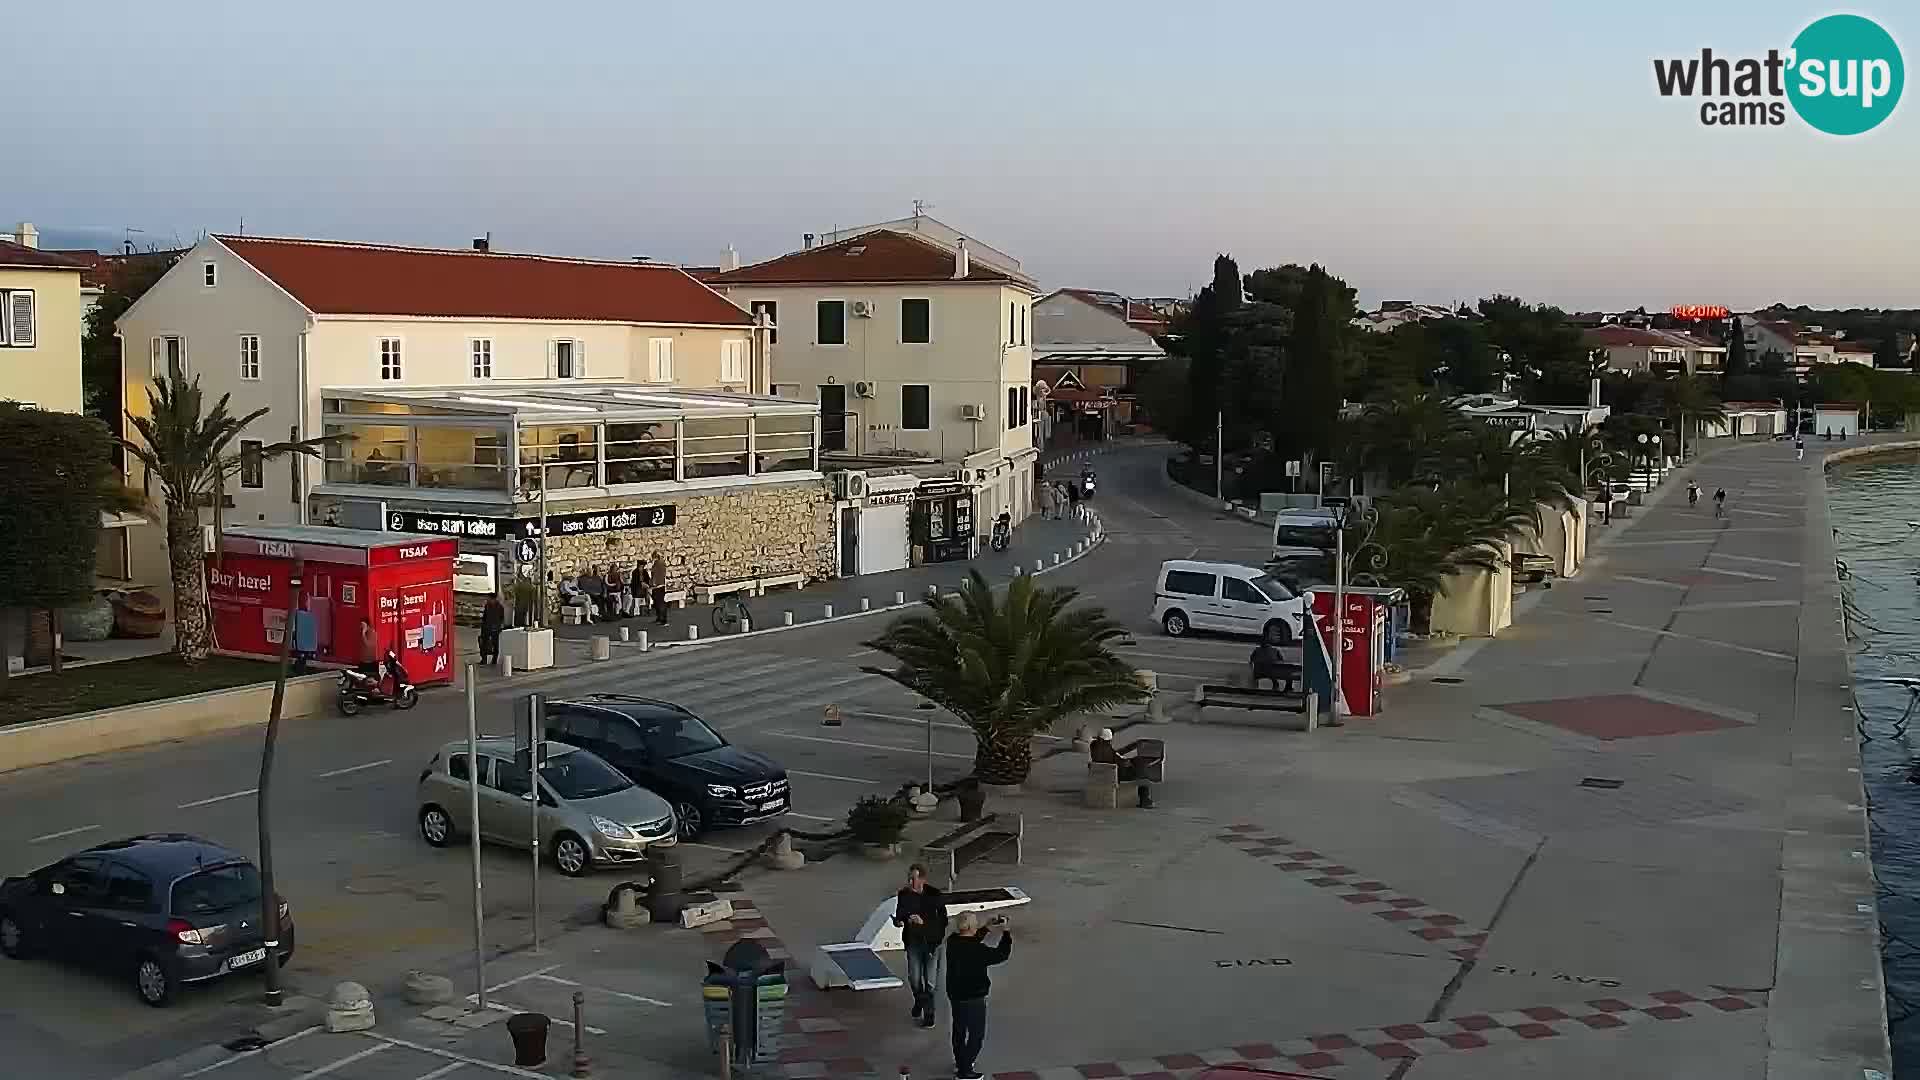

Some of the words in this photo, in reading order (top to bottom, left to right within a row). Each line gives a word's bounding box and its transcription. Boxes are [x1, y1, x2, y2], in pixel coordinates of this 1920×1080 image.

[258, 541, 296, 558] TISAK
[399, 545, 428, 558] TISAK
[210, 567, 235, 588] Buy
[237, 570, 271, 592] here!
[380, 596, 398, 609] Buy
[403, 591, 427, 606] here!
